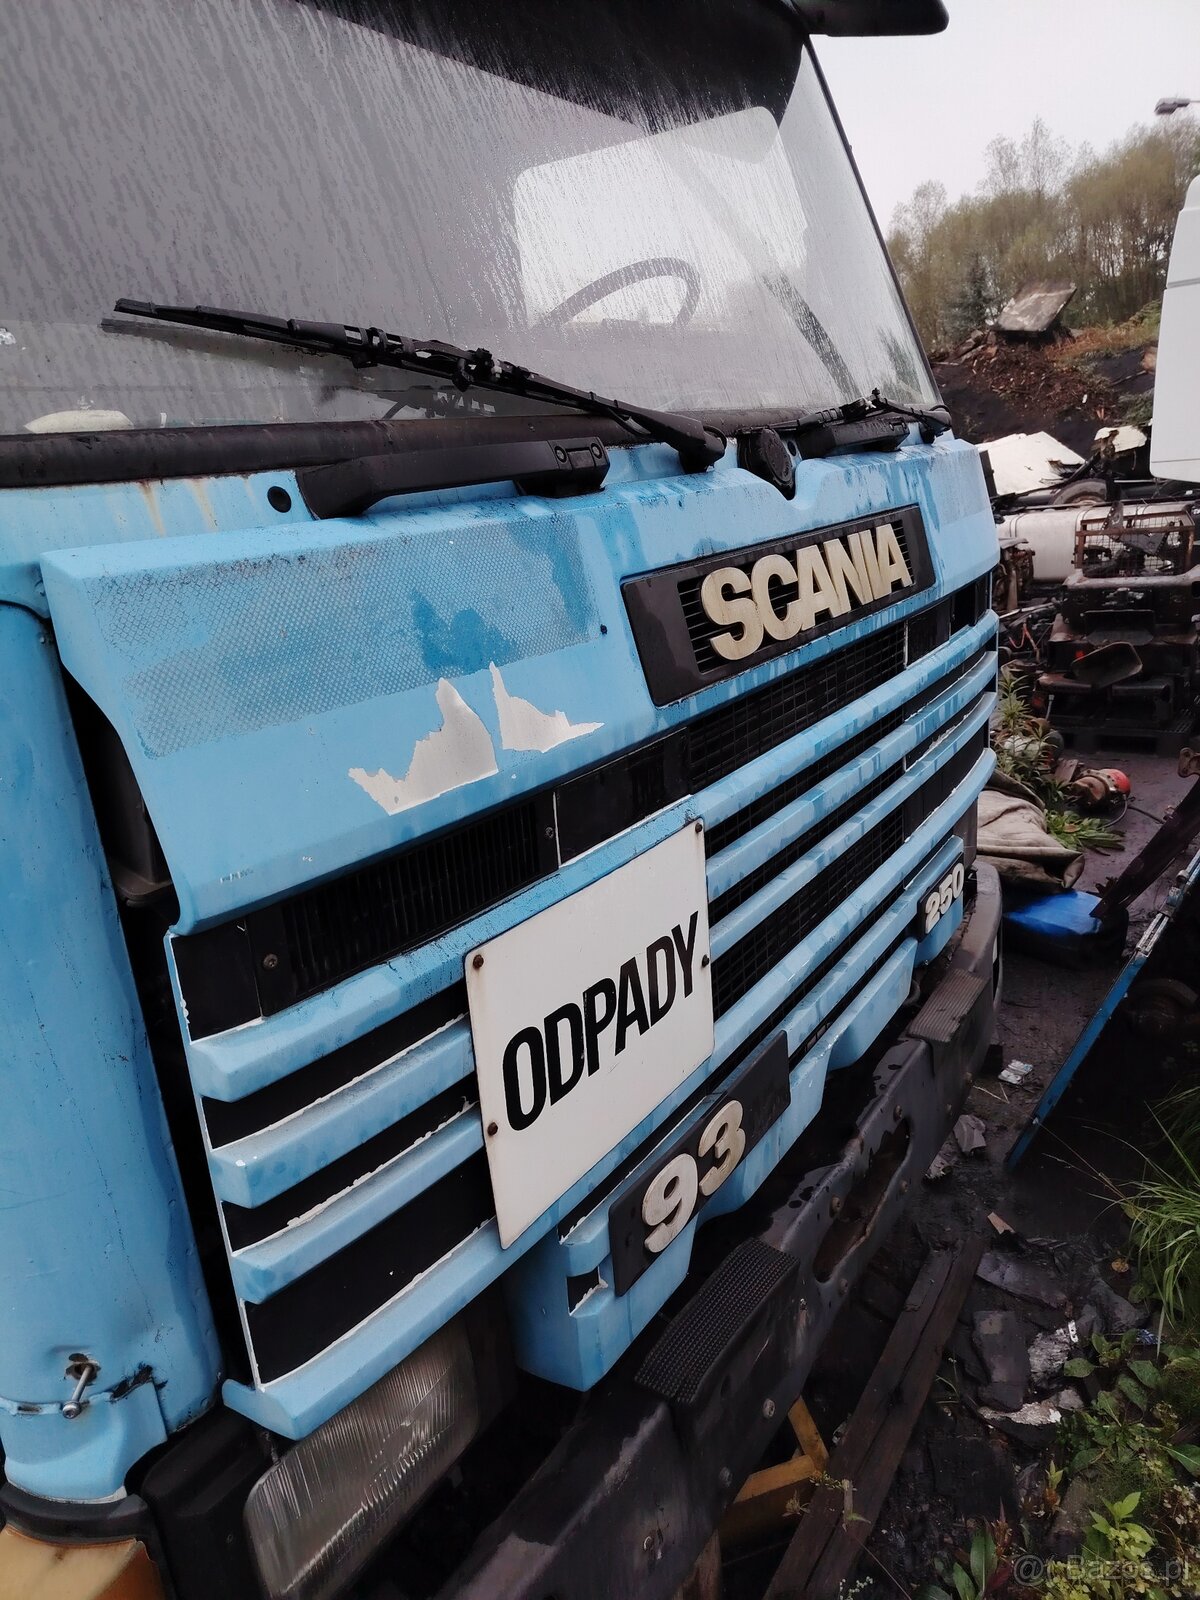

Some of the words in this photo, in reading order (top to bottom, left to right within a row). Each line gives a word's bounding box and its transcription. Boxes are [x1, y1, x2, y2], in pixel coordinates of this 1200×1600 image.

[701, 523, 913, 660] SCANIA
[925, 863, 964, 934] 250
[502, 910, 698, 1132] ODPADY
[642, 1100, 746, 1253] 93
